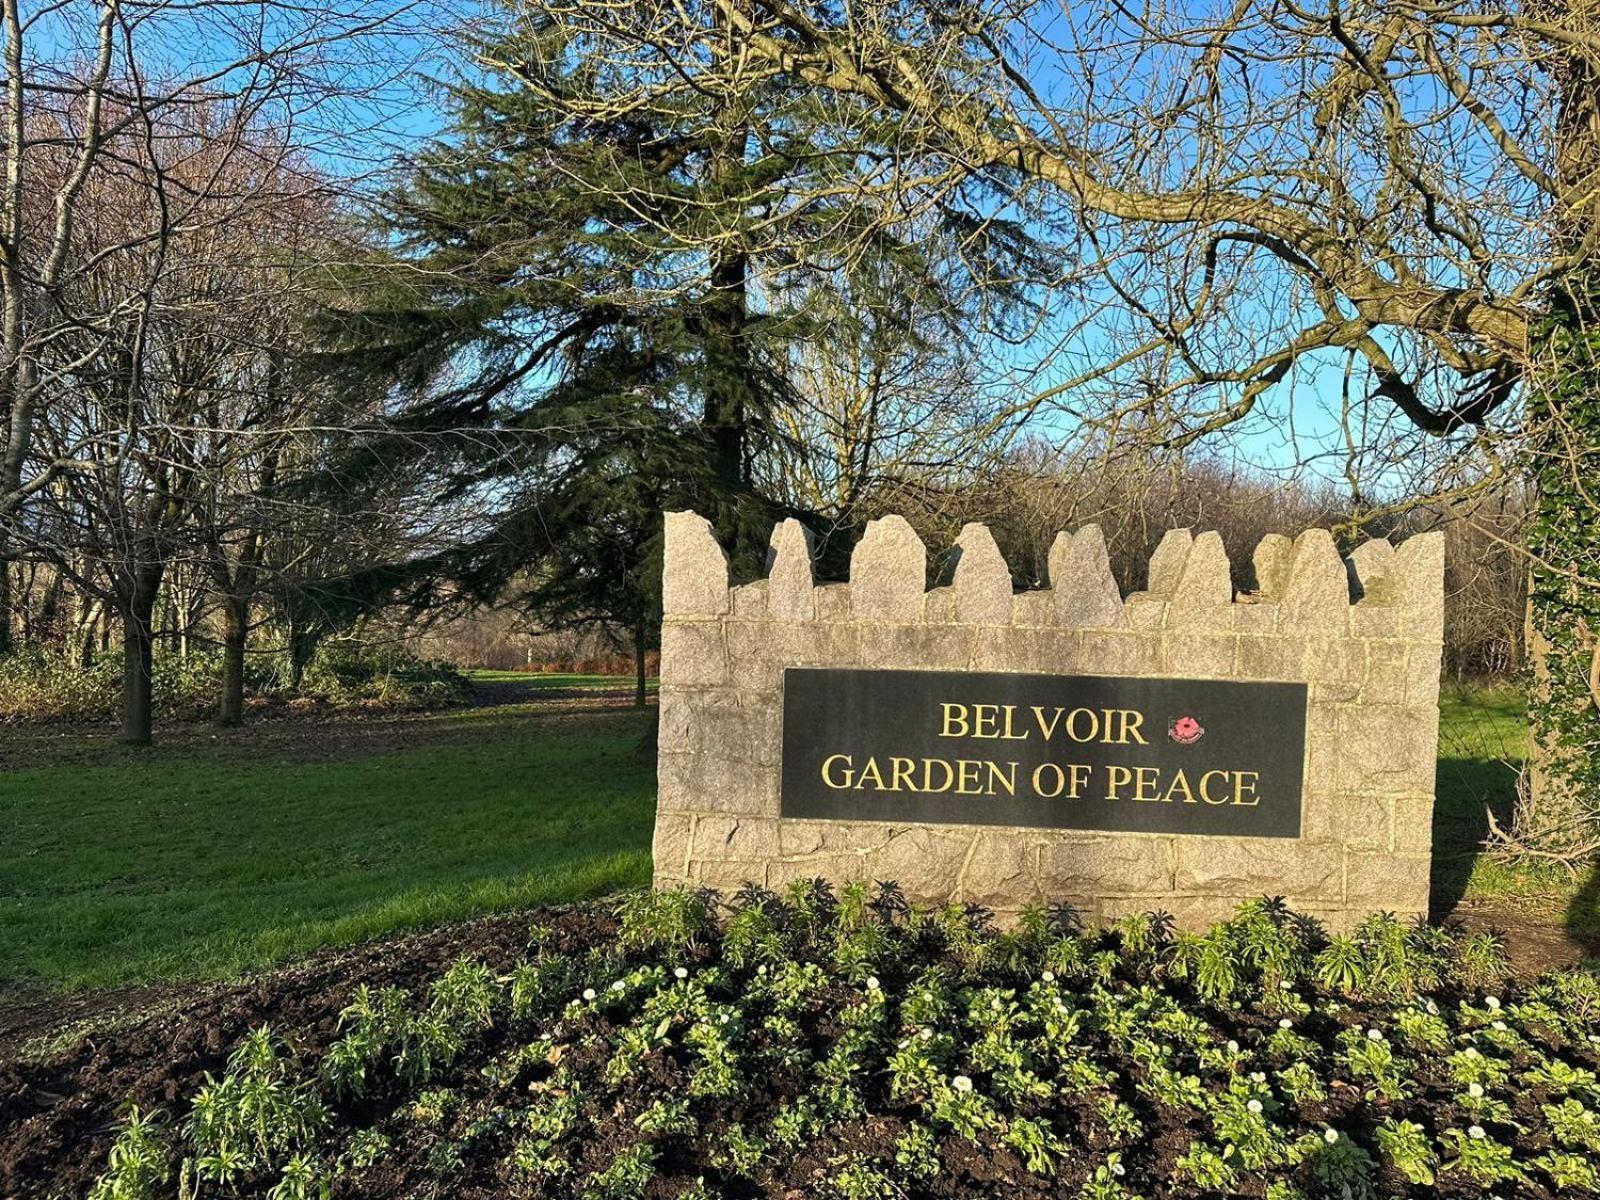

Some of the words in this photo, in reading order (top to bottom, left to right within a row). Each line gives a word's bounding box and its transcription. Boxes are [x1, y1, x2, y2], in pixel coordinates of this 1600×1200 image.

[938, 702, 1149, 746] BELVOIR
[821, 754, 1019, 798] GARDEN
[1032, 762, 1092, 800] OF
[1104, 765, 1261, 807] PEACE
